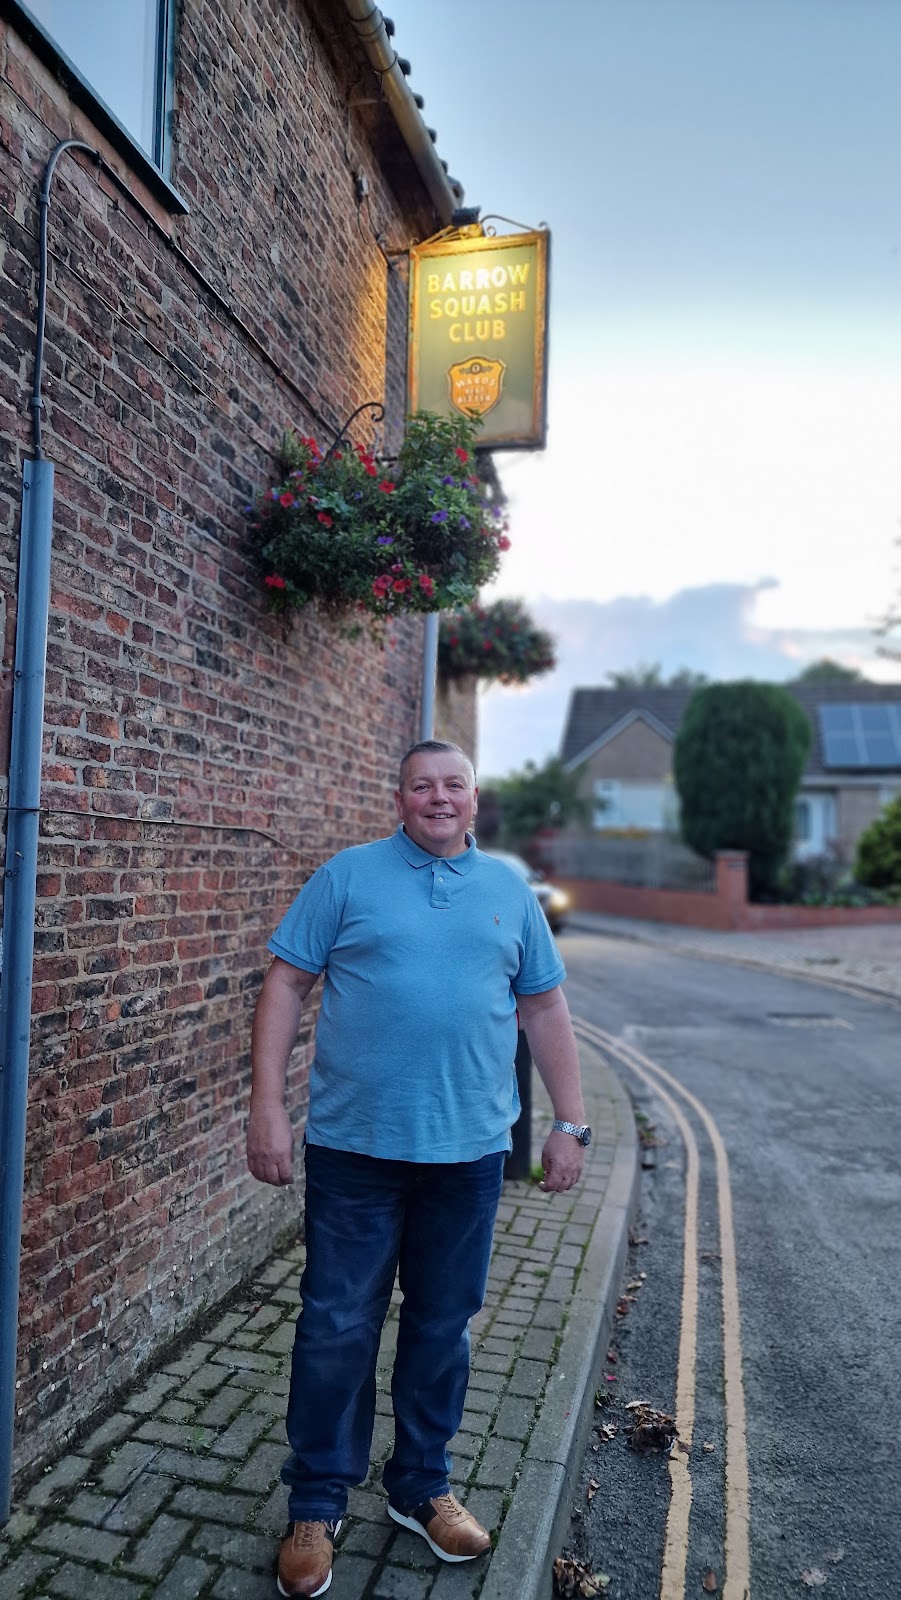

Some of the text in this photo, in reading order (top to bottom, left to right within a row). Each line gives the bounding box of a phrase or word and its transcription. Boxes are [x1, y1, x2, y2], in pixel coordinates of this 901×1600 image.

[427, 263, 529, 292] BARROW
[429, 291, 526, 319] SQUASH
[449, 320, 506, 342] CLUB
